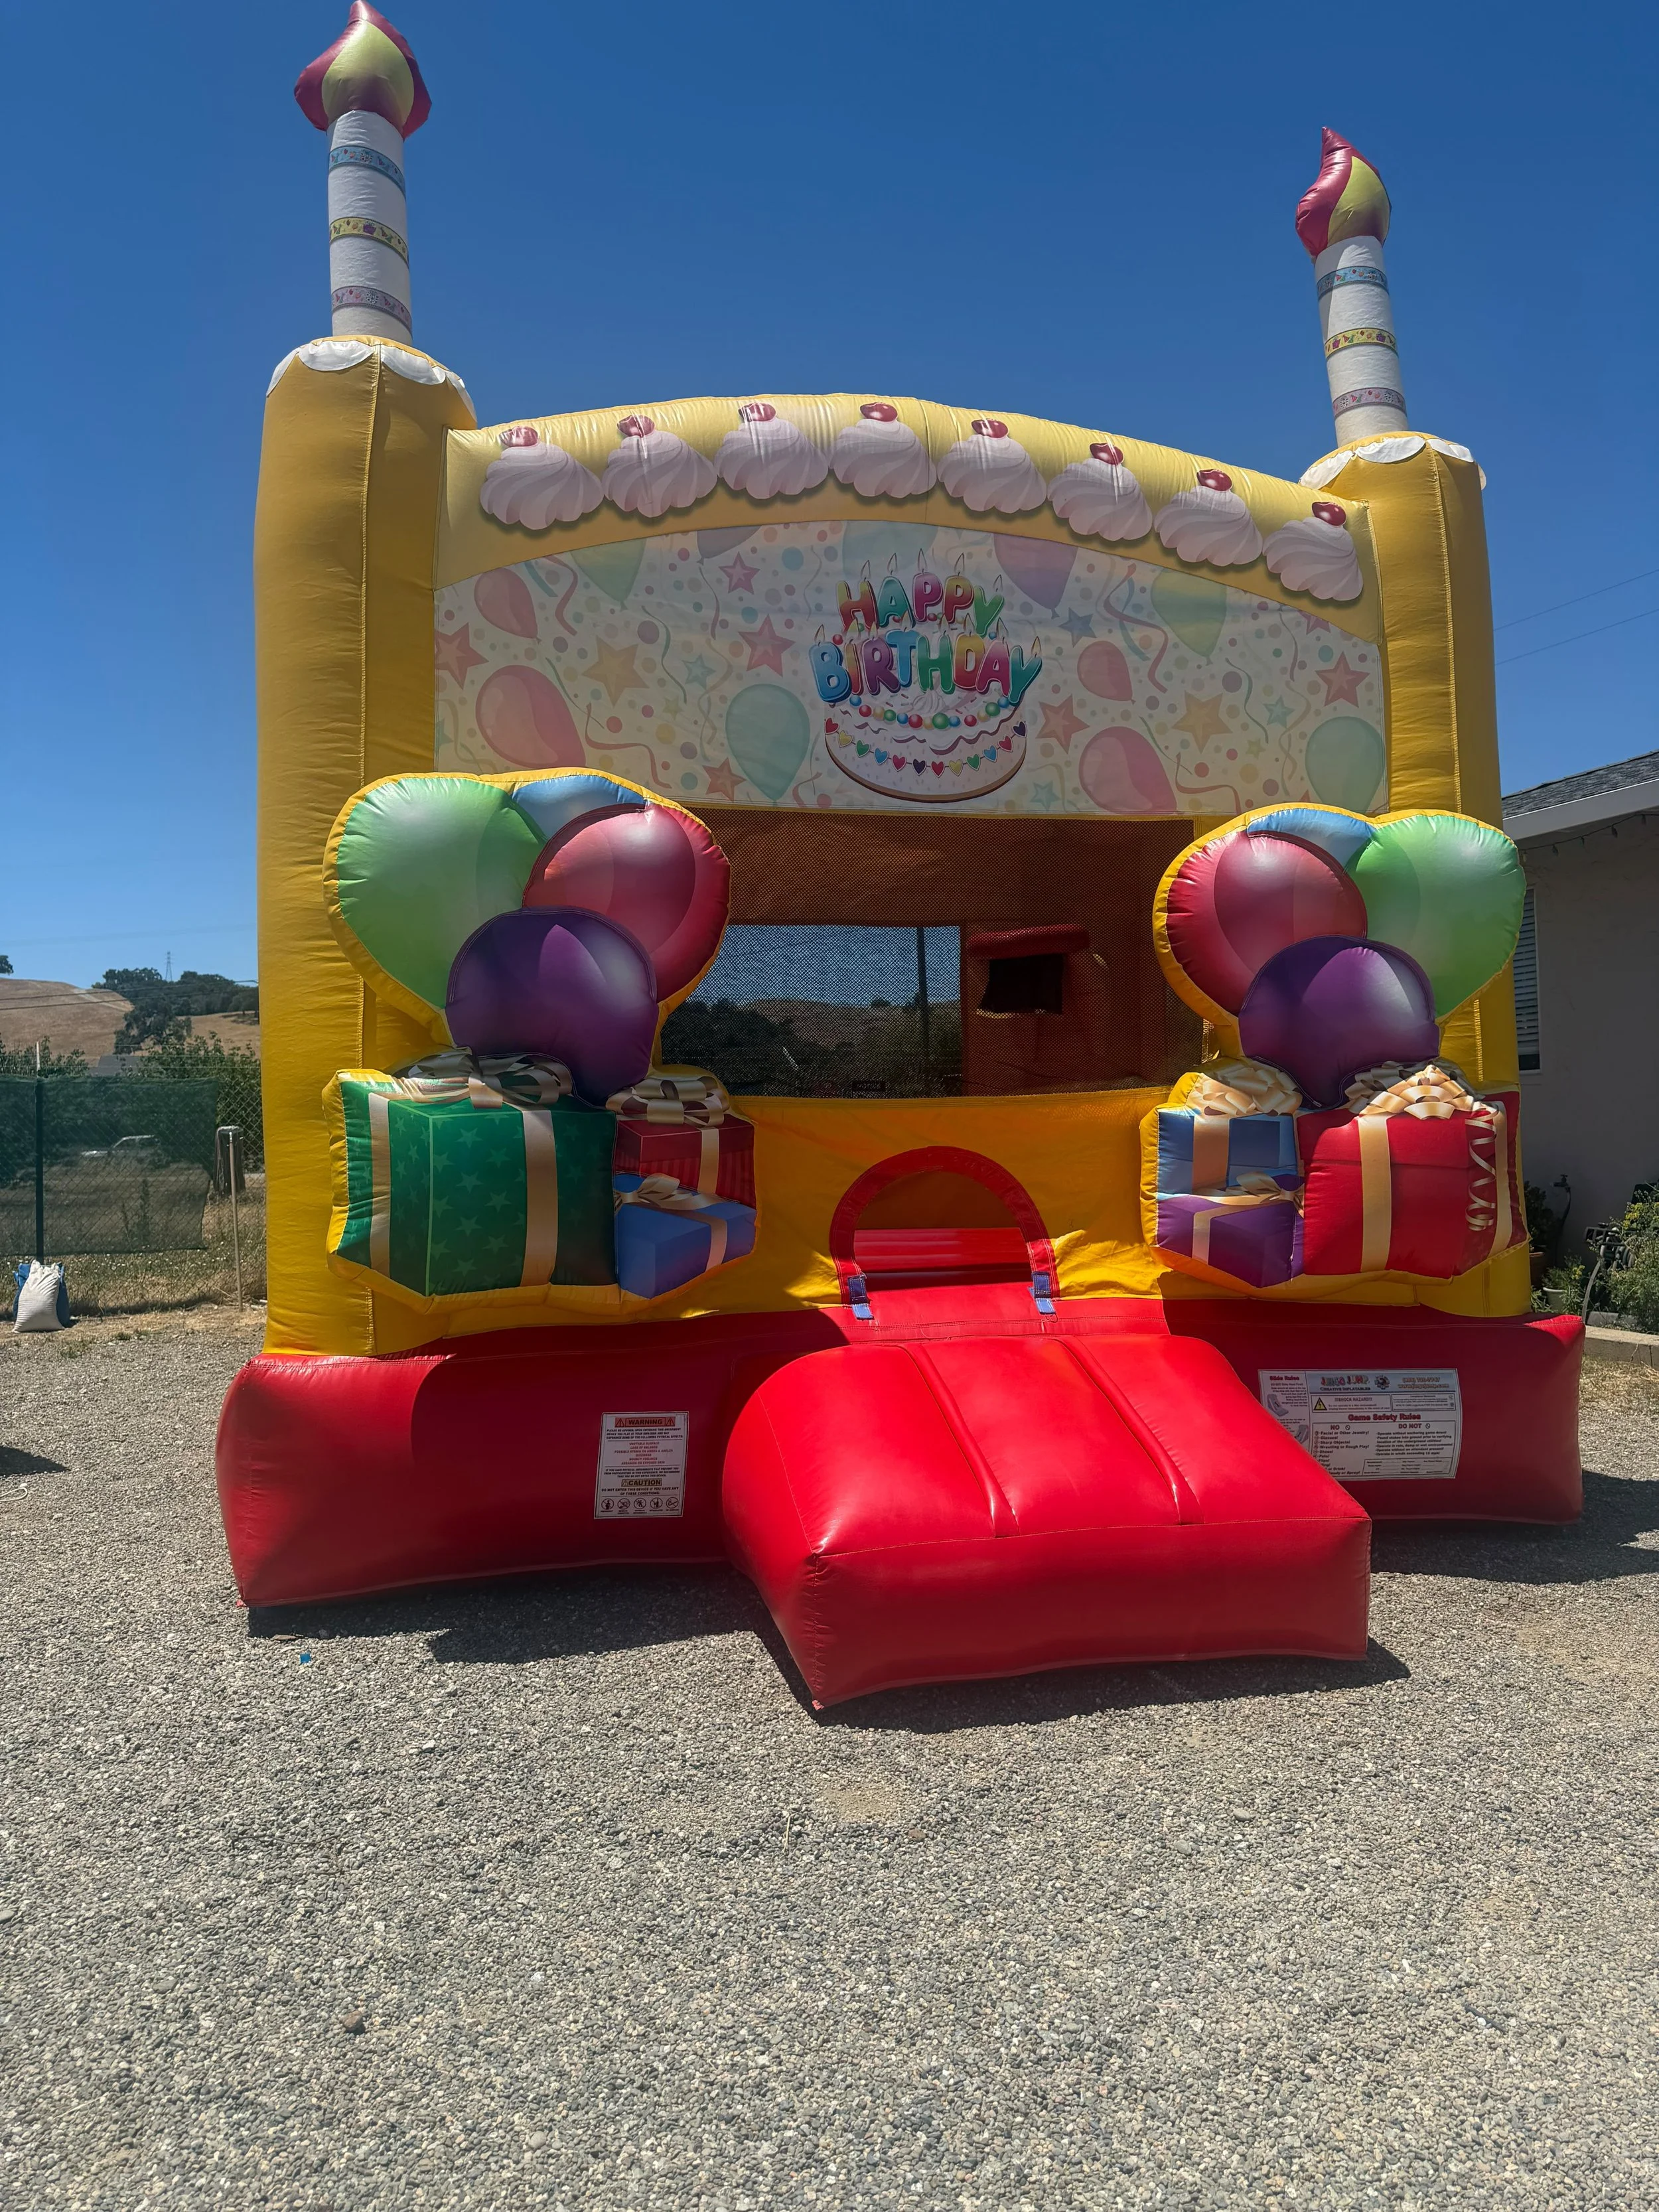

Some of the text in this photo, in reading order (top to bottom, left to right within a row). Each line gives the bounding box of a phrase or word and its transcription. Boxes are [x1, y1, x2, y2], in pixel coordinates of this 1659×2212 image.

[836, 572, 1005, 638] HAPPY
[809, 628, 1043, 705] BIRTHDAY
[1373, 1413, 1397, 1422] Safety
